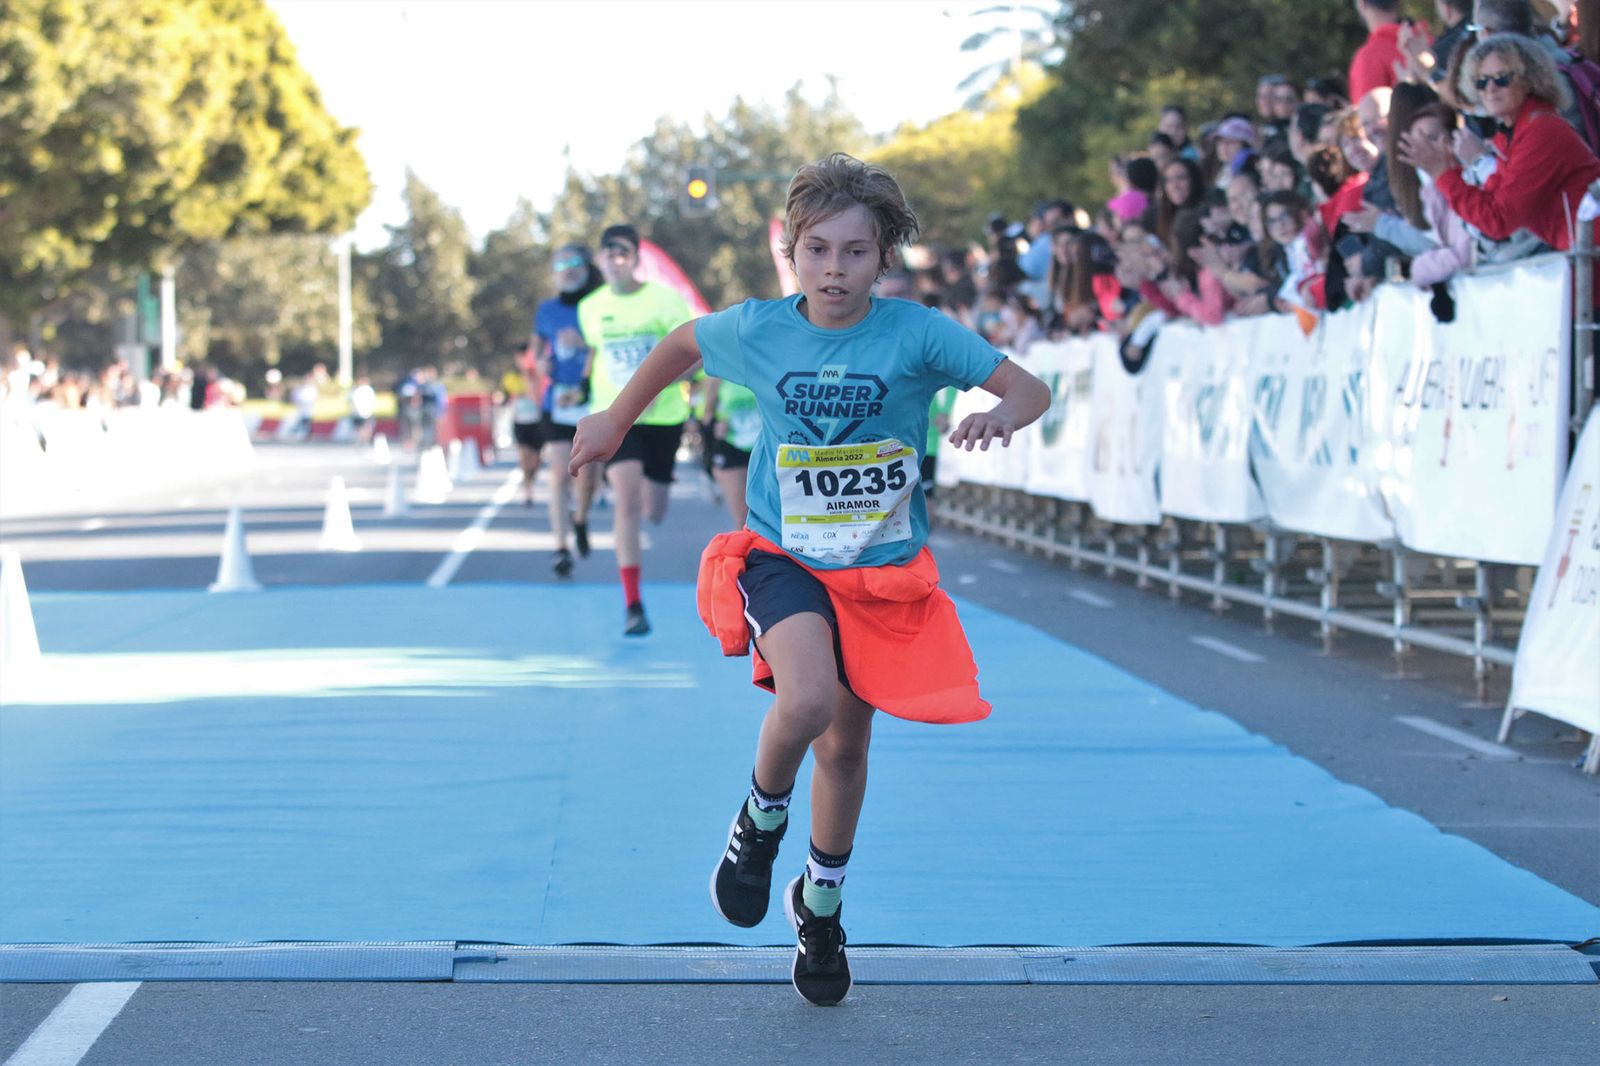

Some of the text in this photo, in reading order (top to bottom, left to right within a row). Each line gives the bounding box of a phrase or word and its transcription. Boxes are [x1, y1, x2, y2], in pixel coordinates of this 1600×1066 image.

[792, 383, 872, 402] SUPER
[784, 399, 883, 418] RUNNER
[844, 453, 864, 462] 2022
[795, 459, 907, 497] 10235
[826, 499, 880, 511] AIRAMOR
[822, 529, 839, 540] COX
